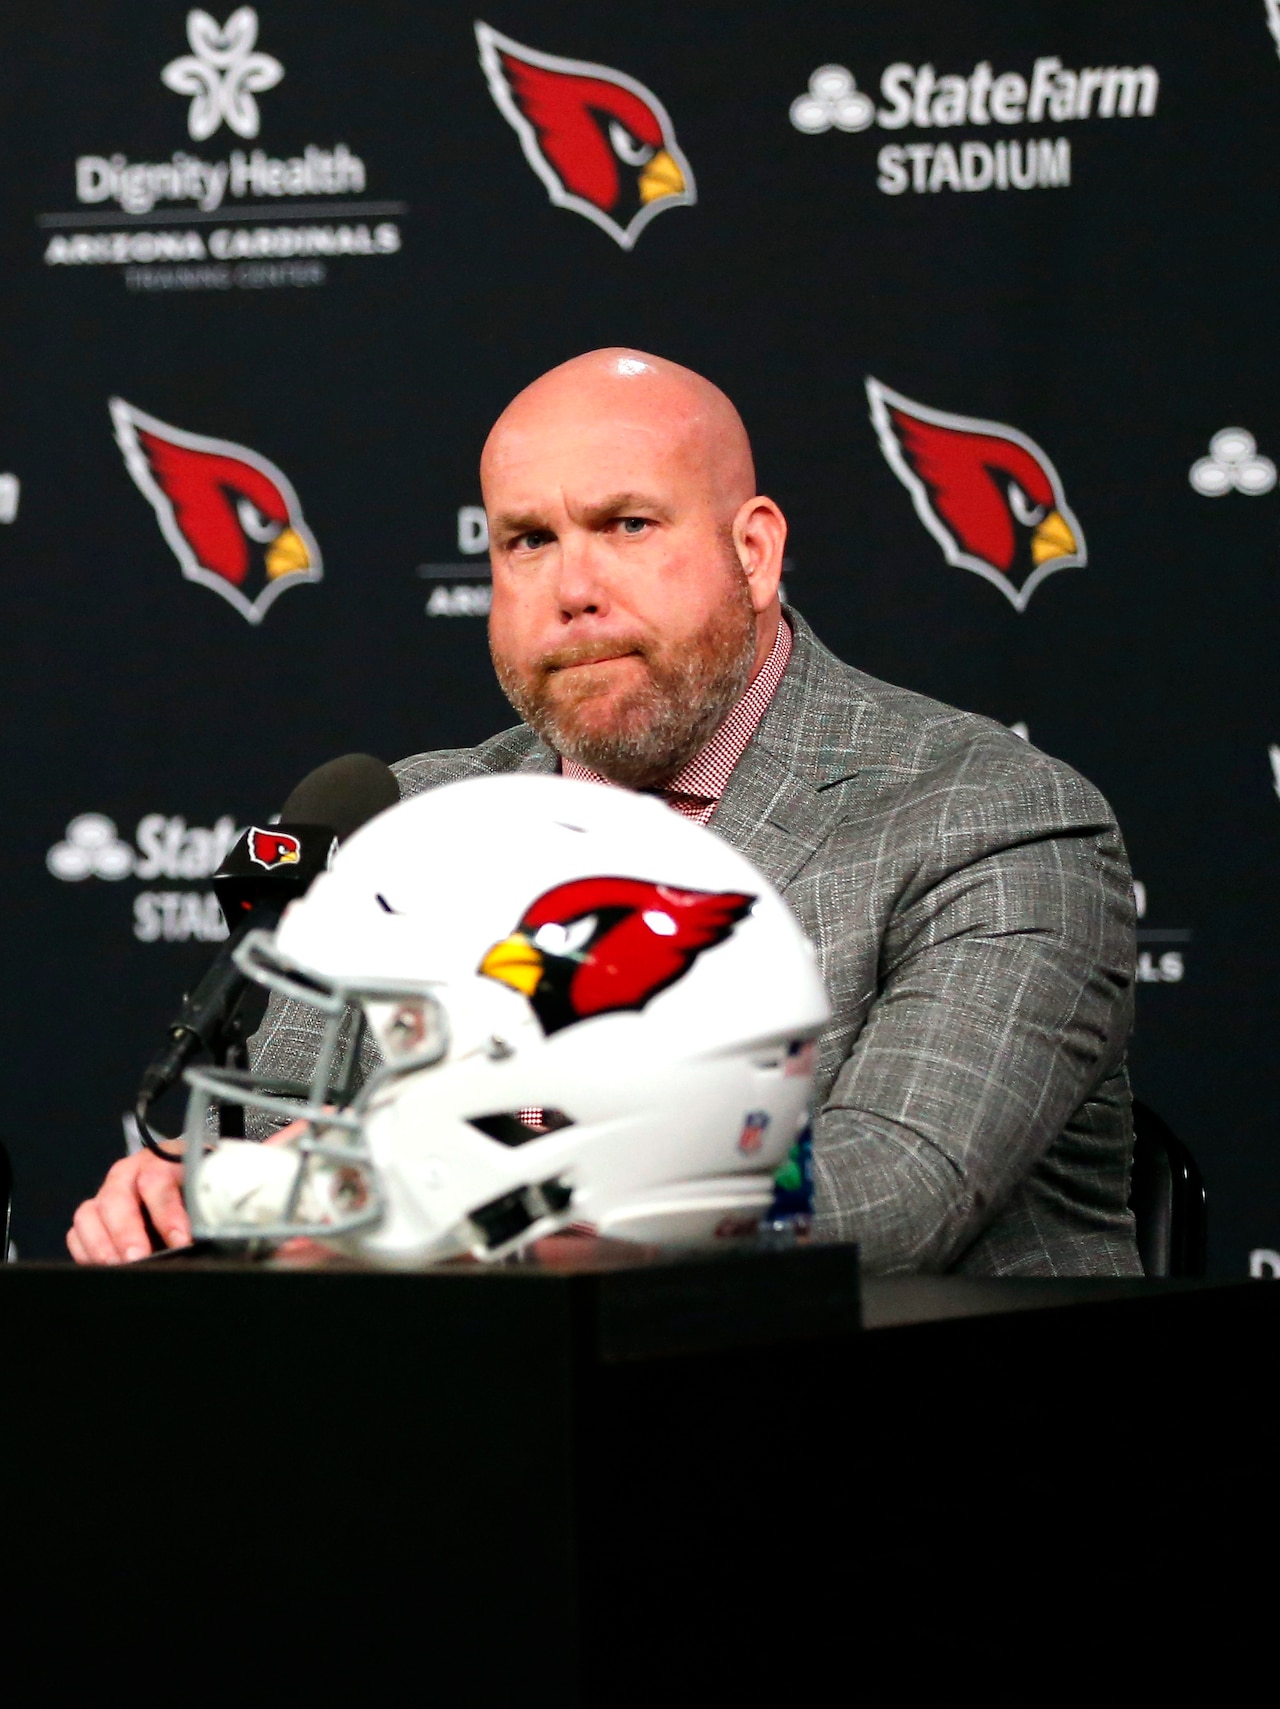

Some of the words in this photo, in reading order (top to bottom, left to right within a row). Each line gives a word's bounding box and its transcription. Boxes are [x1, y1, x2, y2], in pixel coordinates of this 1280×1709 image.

[75, 153, 229, 215] Dignity
[229, 144, 366, 197] Health
[876, 137, 1071, 195] STADIUM
[44, 231, 207, 265] ARIZONA
[208, 223, 402, 260] CARDINALS
[132, 891, 230, 942] STAD
